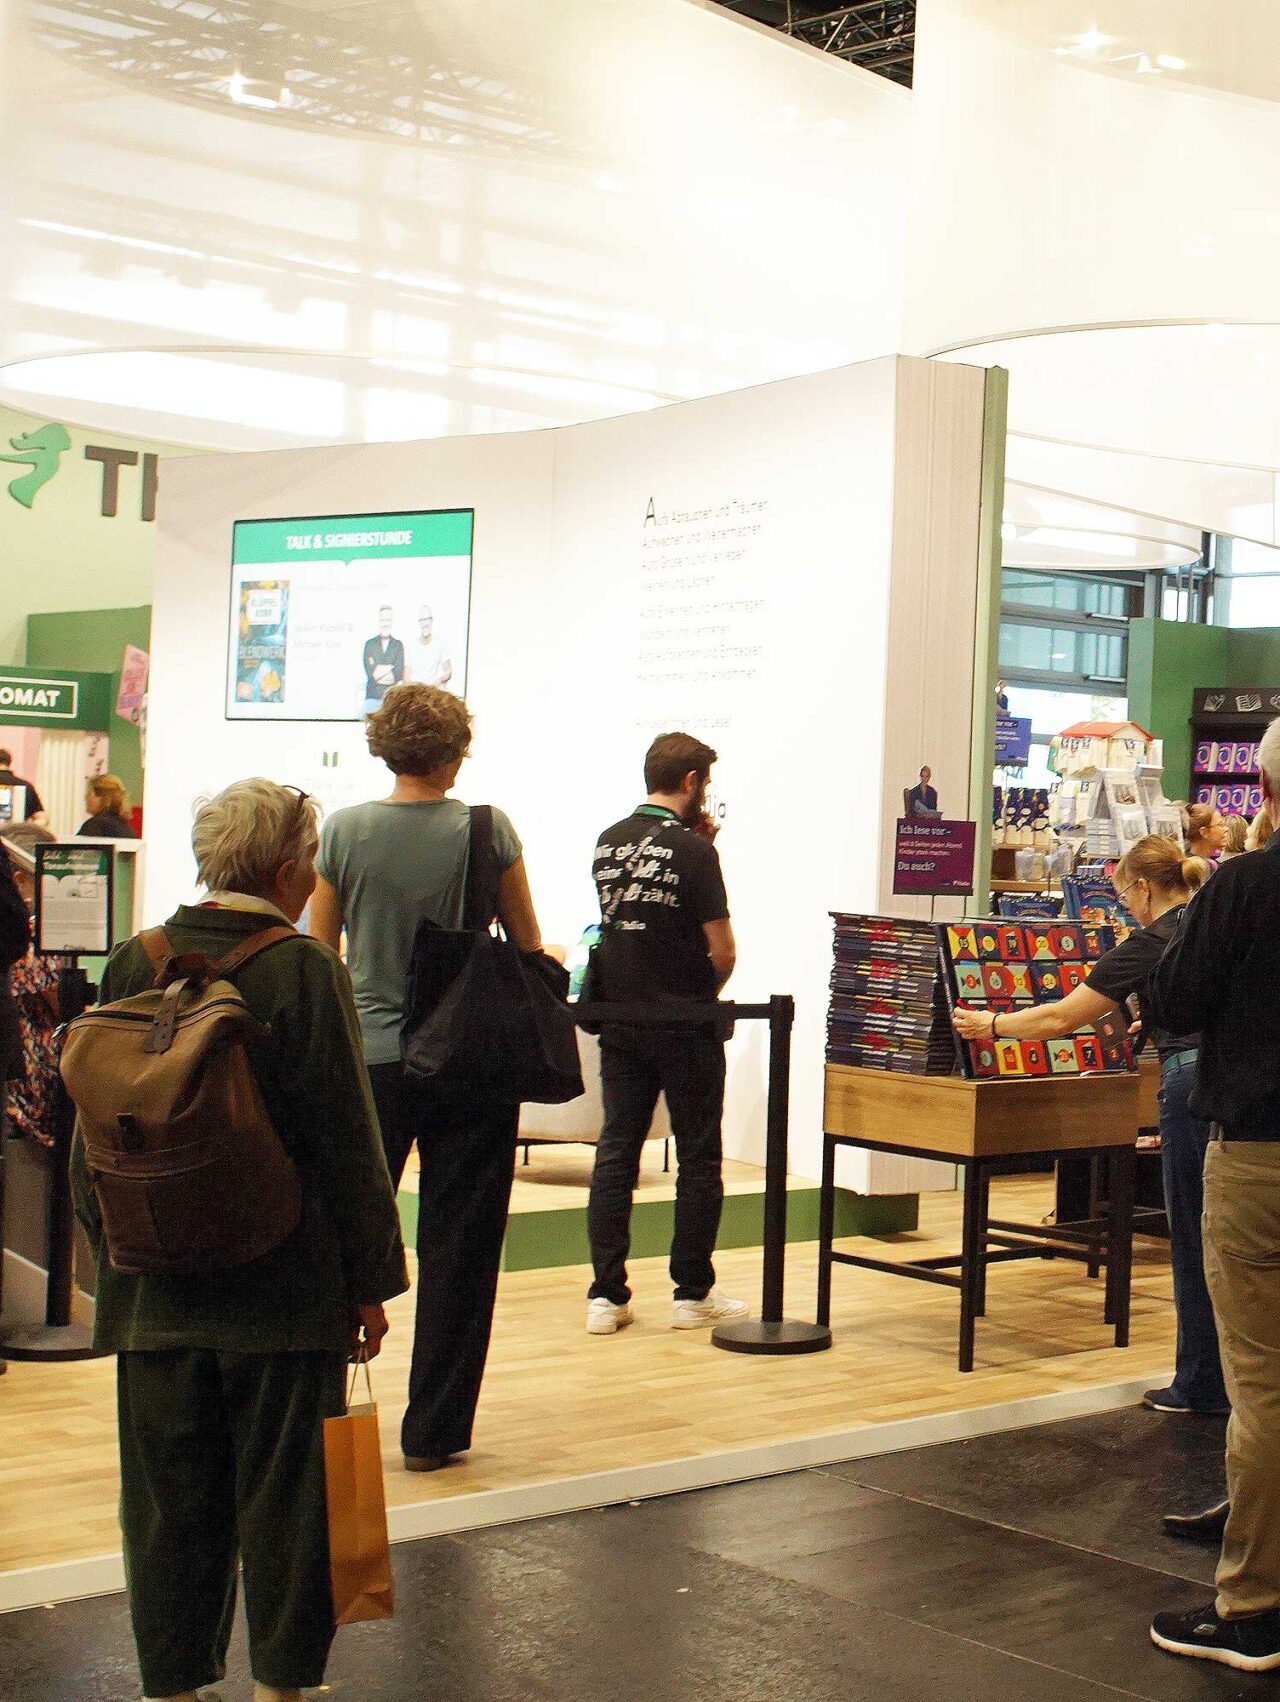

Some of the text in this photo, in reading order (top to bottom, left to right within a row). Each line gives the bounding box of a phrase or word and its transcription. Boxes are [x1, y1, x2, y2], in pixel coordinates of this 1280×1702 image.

[285, 530, 413, 550] TALK & SIGNIERSTUNDE
[0, 687, 60, 707] OMAT
[899, 825, 913, 834] Ich
[914, 825, 929, 835] lese
[931, 827, 945, 835] vor
[897, 862, 936, 871] Du auch?
[663, 868, 679, 885] in
